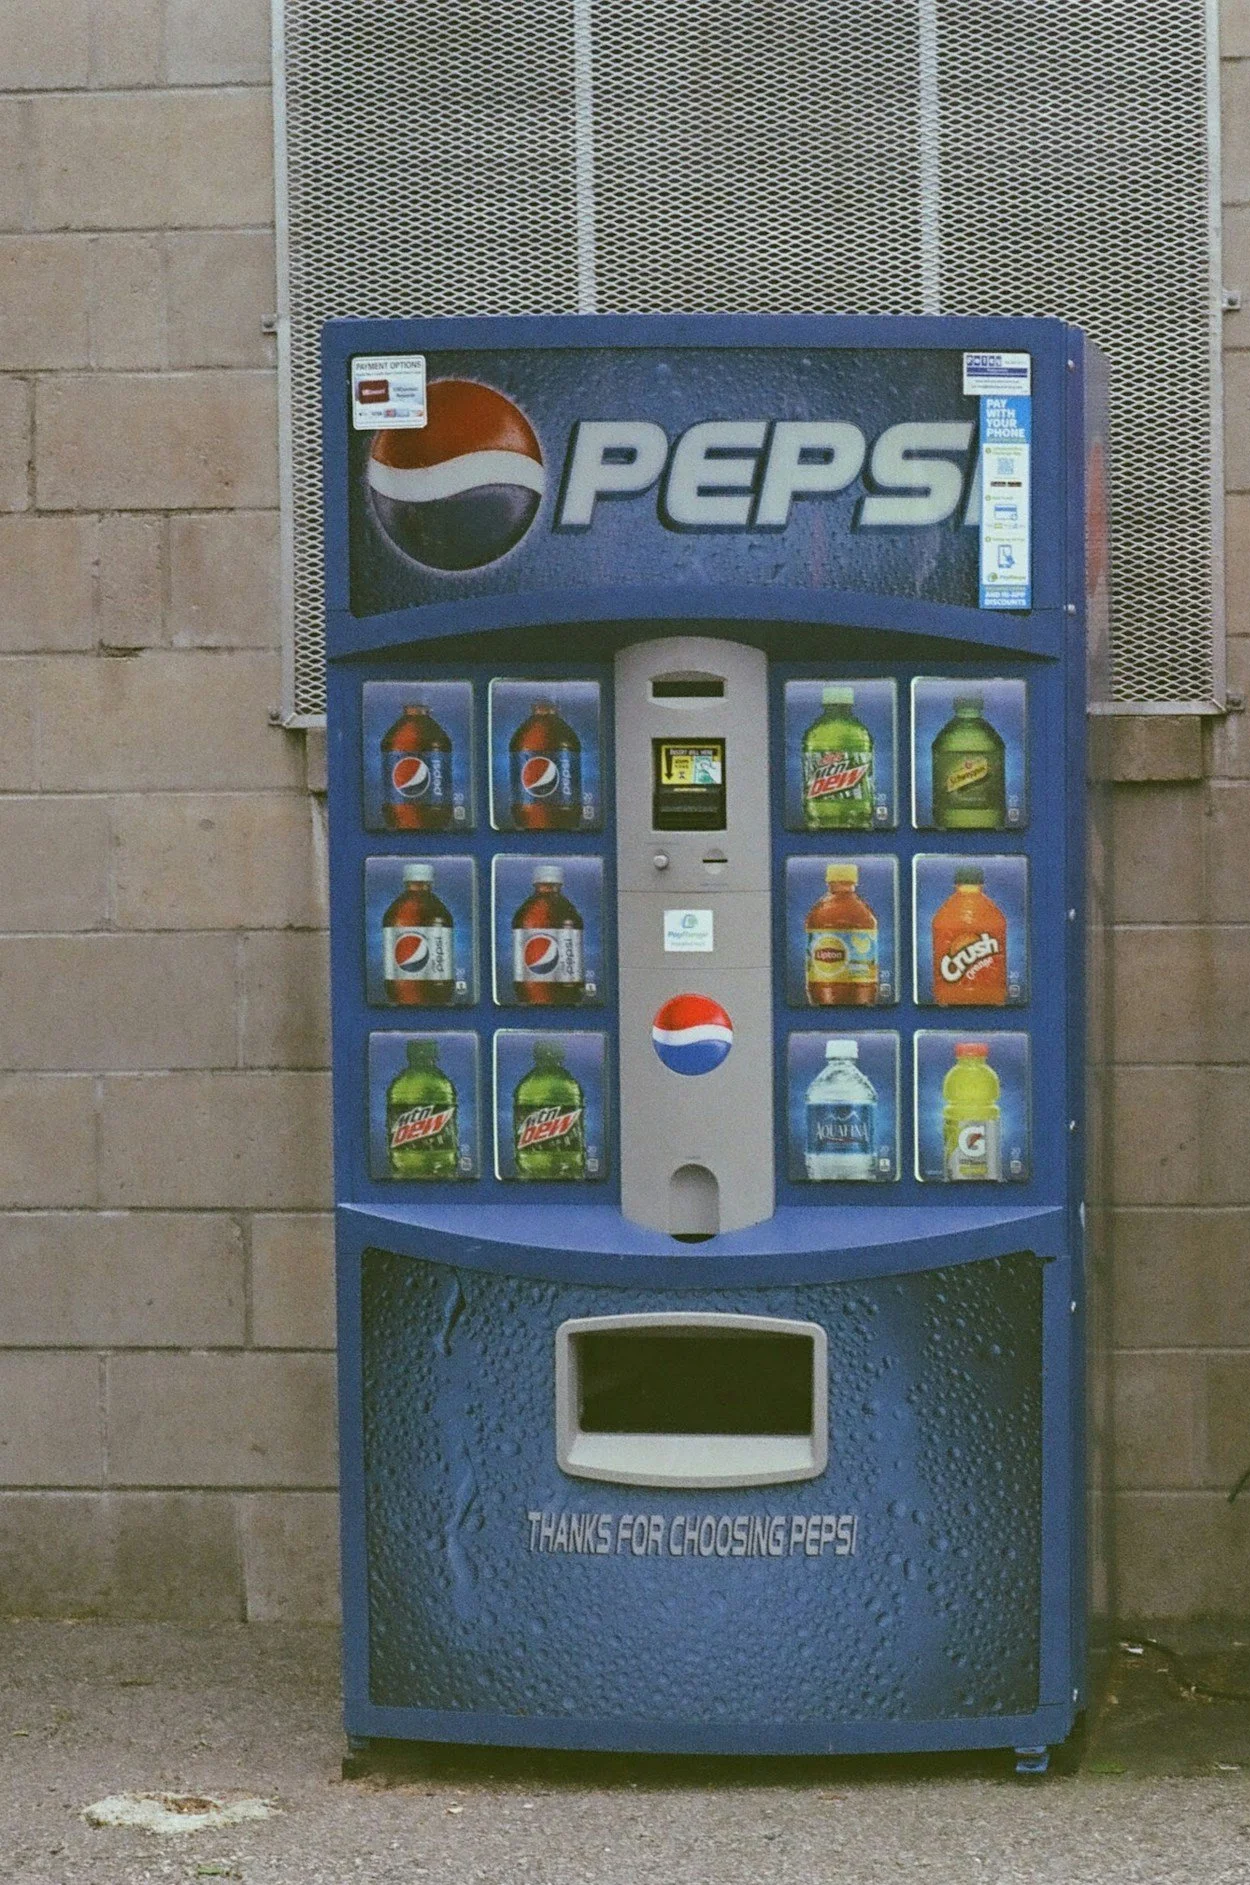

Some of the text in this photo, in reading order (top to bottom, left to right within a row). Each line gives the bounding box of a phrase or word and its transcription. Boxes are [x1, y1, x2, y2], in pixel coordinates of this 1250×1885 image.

[390, 361, 422, 369] OPTIONS
[987, 399, 1007, 409] PAY
[986, 409, 1016, 418] WITH
[987, 418, 1017, 428] YOUR
[987, 428, 1025, 437] PHONE
[816, 951, 843, 961] Lipton
[940, 932, 1000, 982] Crush
[958, 1125, 986, 1158] G
[527, 1512, 857, 1557] THANKS FOR CHOOSING PEPSI
